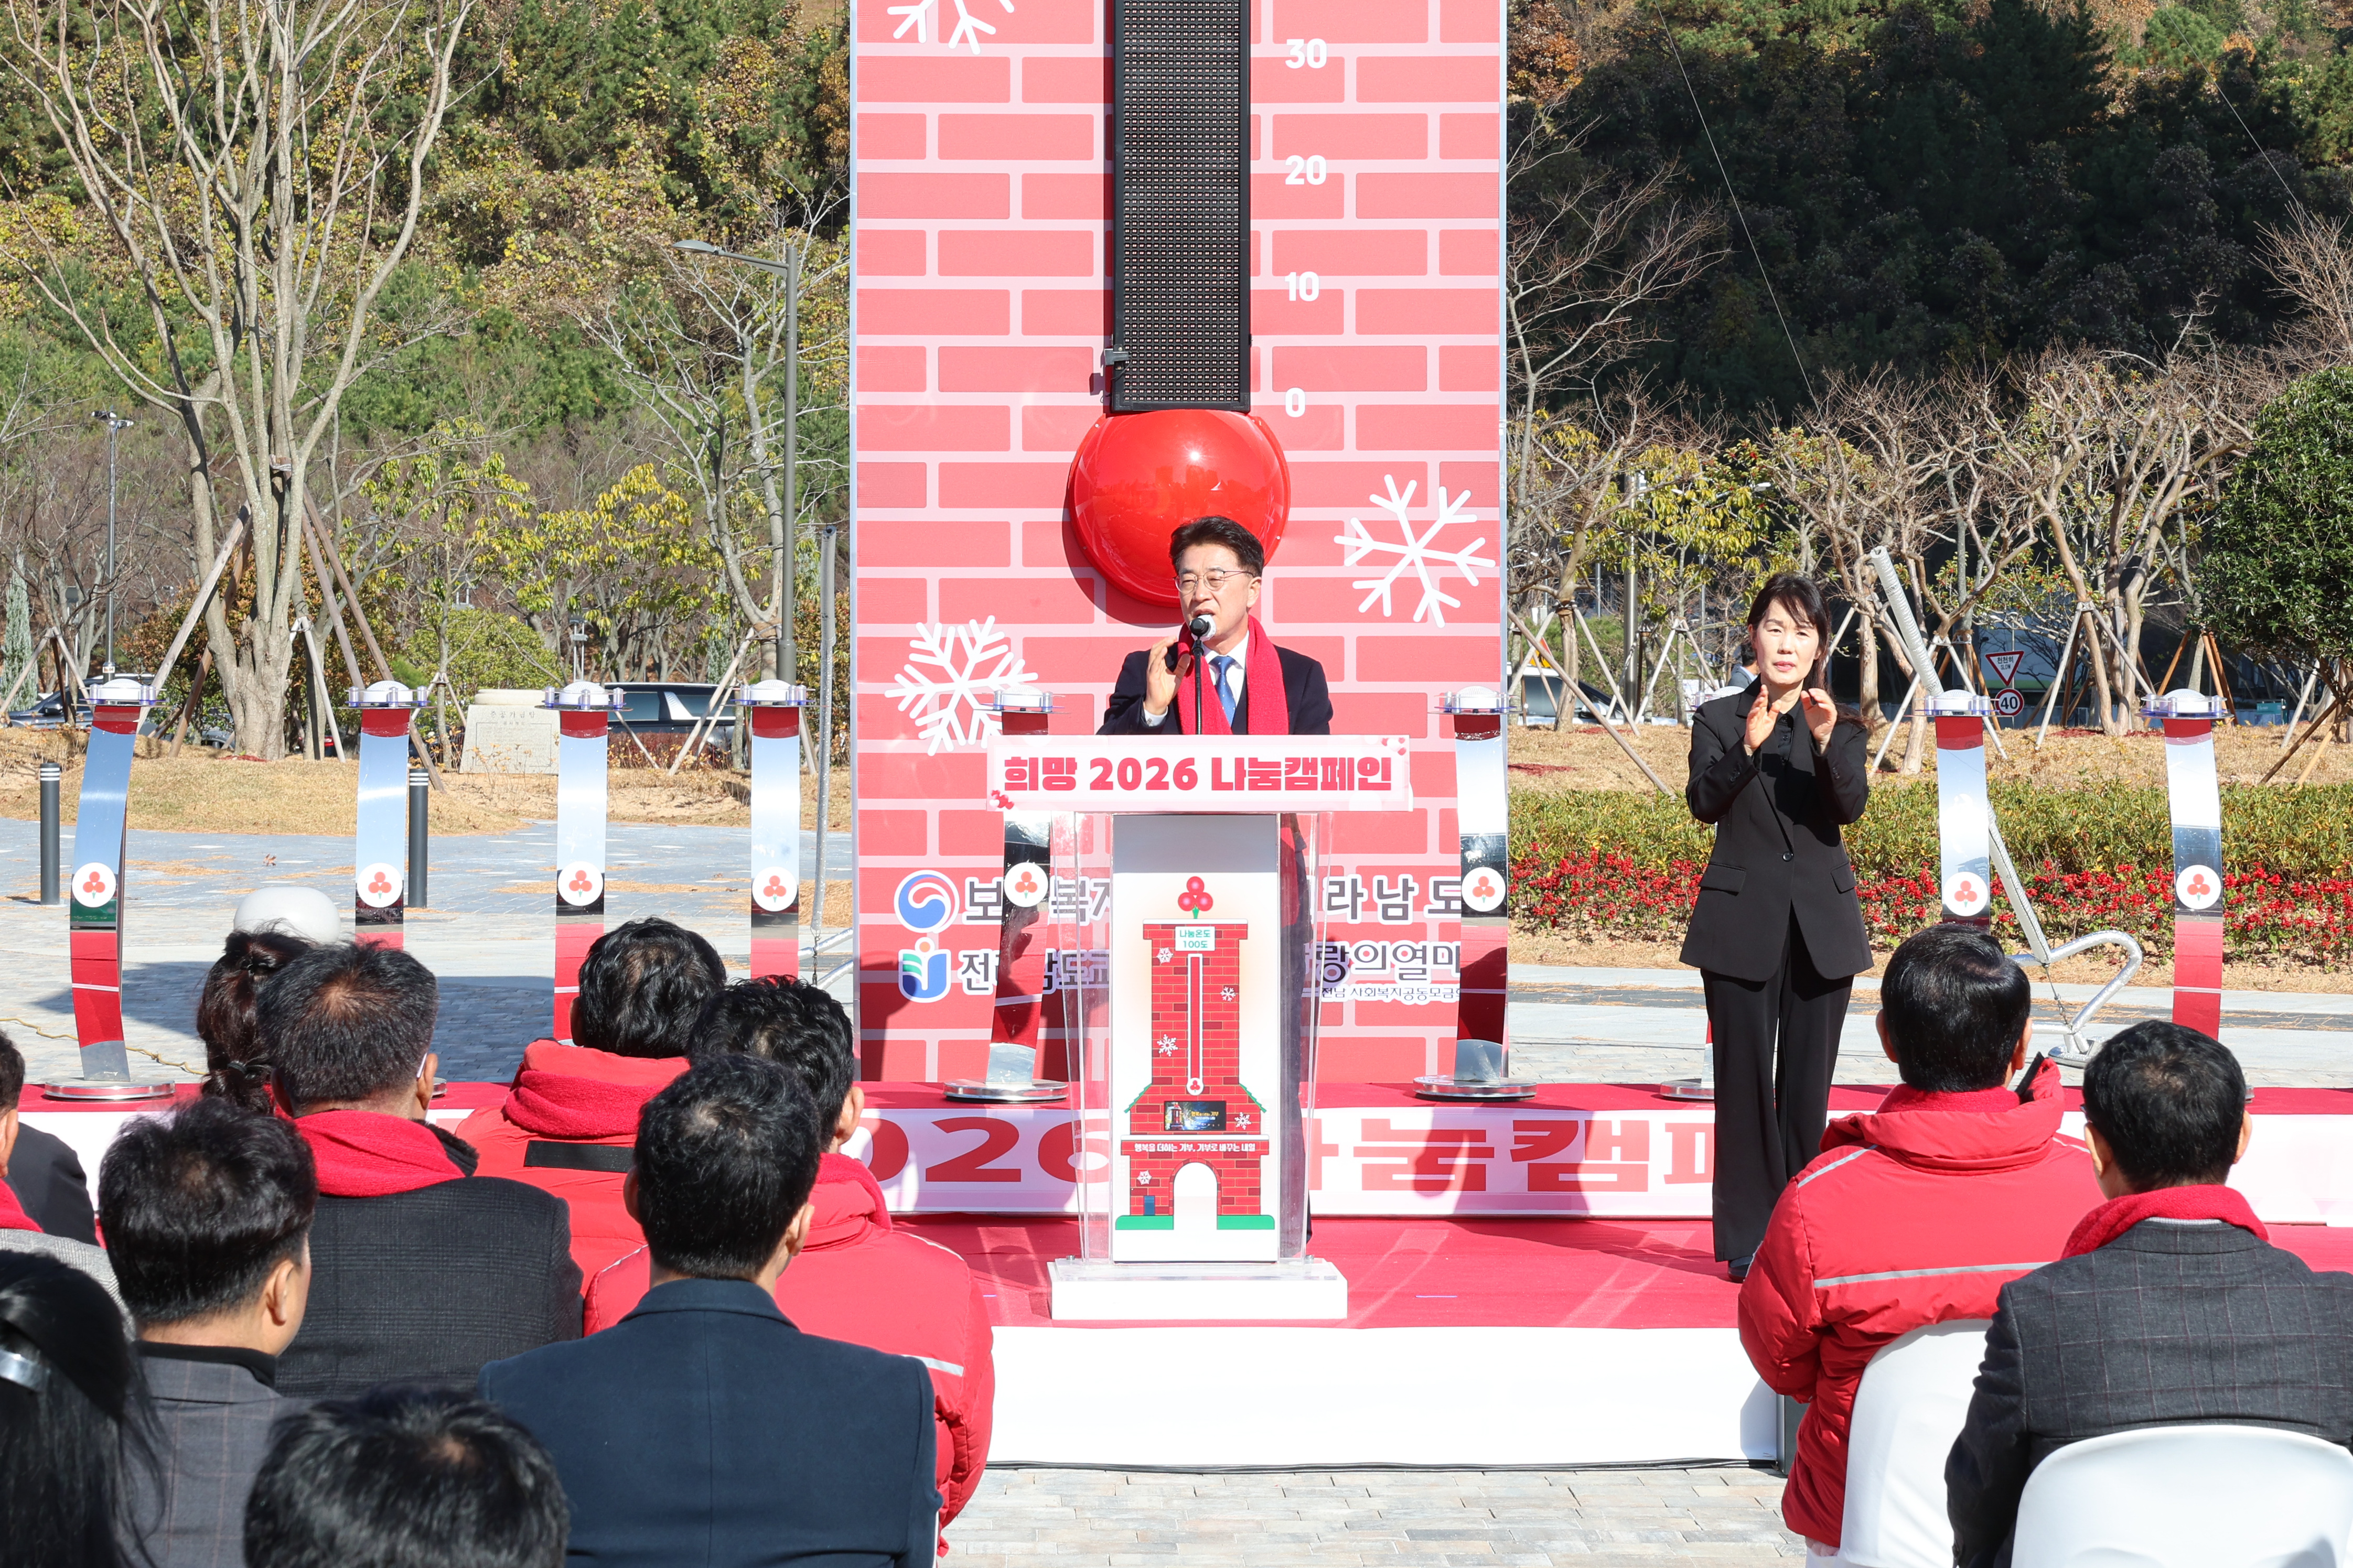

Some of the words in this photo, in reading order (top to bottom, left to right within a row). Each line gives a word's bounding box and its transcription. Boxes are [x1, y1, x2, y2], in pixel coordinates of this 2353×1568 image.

[1285, 38, 1327, 69] 30
[1285, 155, 1327, 185] 20
[1284, 271, 1320, 301] 10
[1285, 387, 1306, 417] 0
[2001, 696, 2018, 709] 40
[1004, 756, 1077, 791] 희망
[1089, 757, 1198, 791] 2026
[1211, 757, 1392, 791] 나눔캠페인
[1180, 929, 1210, 938] 나눔온도
[1322, 988, 1346, 998] 전남
[1134, 1143, 1155, 1152] 행복을
[1157, 1143, 1177, 1152] 더하는
[1197, 1143, 1218, 1152] 기부로
[1219, 1143, 1240, 1152] 바꾸는
[1241, 1143, 1255, 1152] 내일
